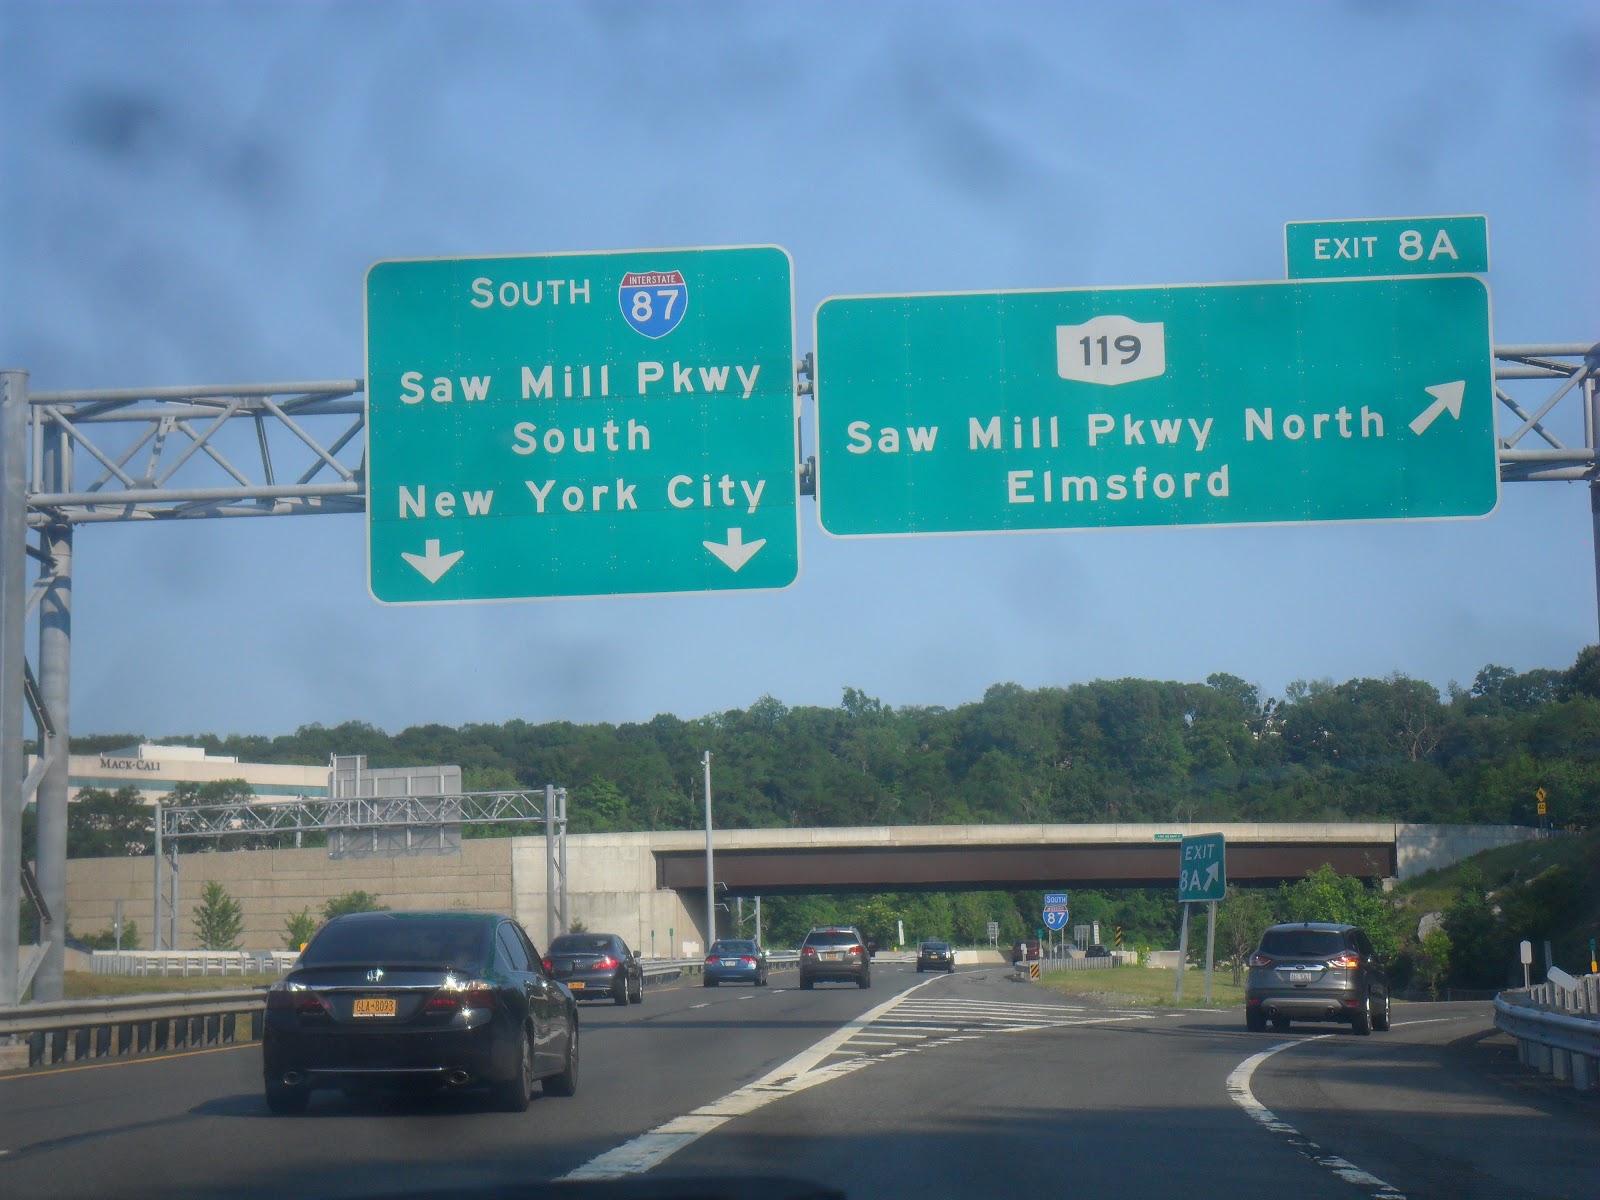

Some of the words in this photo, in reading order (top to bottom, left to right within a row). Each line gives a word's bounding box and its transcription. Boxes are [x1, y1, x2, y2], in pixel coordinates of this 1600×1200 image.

[1313, 236, 1378, 260] EXIT
[1398, 229, 1459, 261] 8A
[470, 277, 591, 309] SOUTH
[629, 274, 676, 285] INTERSTATE
[631, 289, 679, 322] 87
[1079, 334, 1142, 366] 119
[400, 371, 491, 404] Saw
[521, 364, 610, 399] Mill
[638, 361, 760, 399] Pkwy
[511, 418, 651, 455] South
[846, 420, 938, 454] Saw
[968, 415, 1059, 450] Mill
[1088, 411, 1213, 452] Pkwy
[1245, 404, 1384, 442] North
[399, 484, 493, 519] New
[525, 478, 638, 514] York
[667, 474, 766, 514] City
[1007, 464, 1230, 504] Elmsford
[1185, 843, 1215, 861] EXIT
[1180, 869, 1201, 892] 8A
[1046, 895, 1066, 904] SOUTH
[1047, 912, 1066, 925] 87
